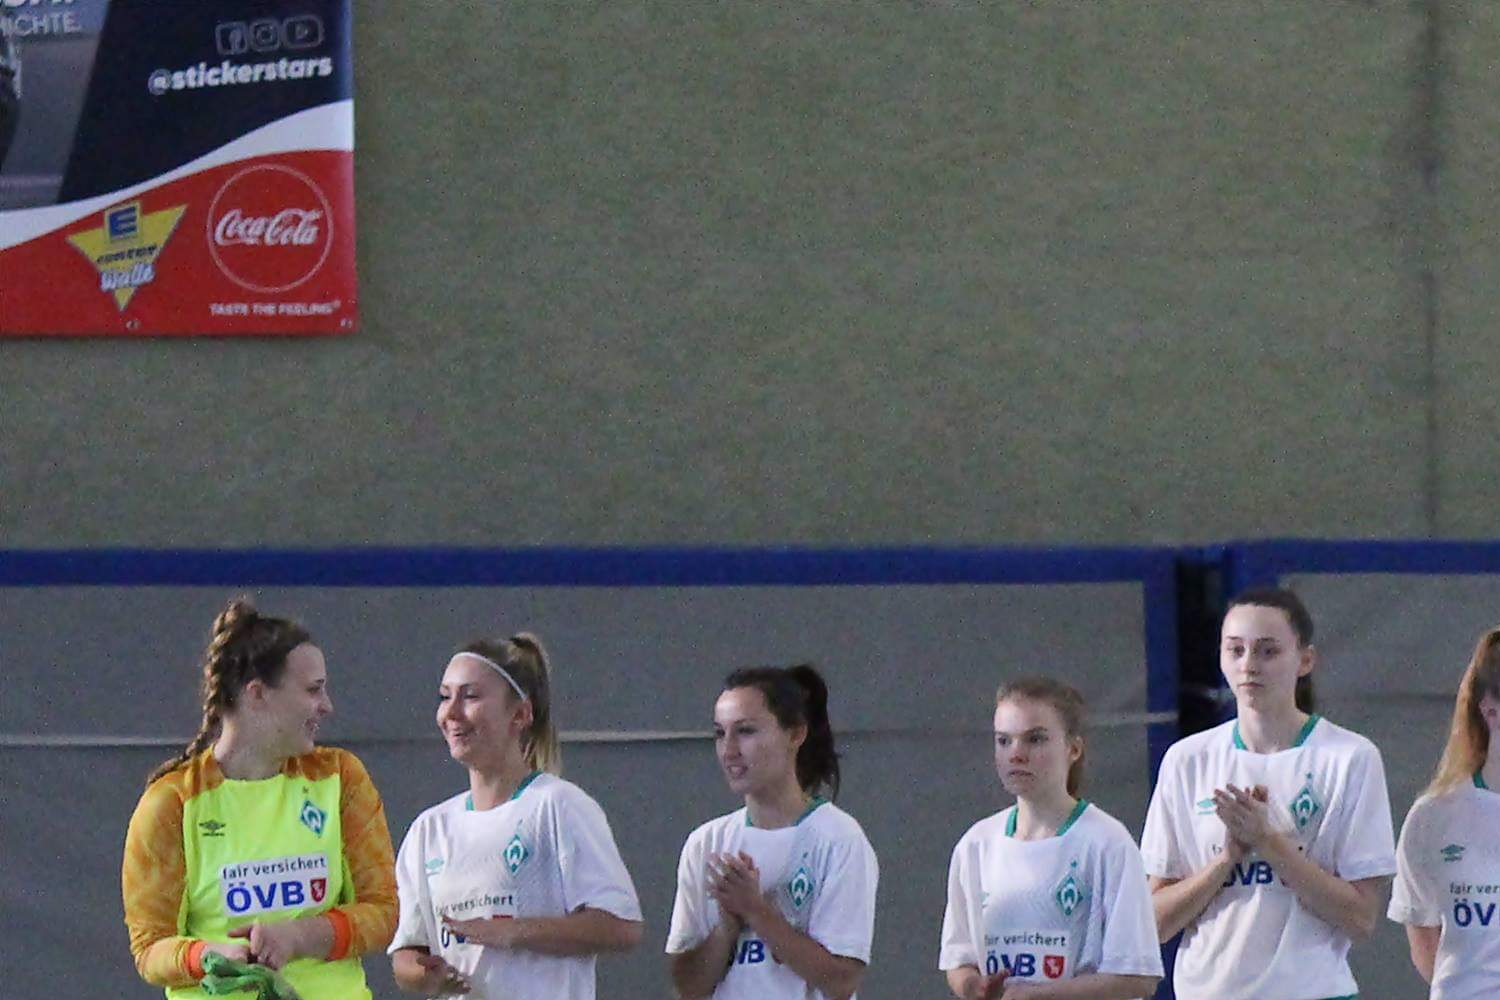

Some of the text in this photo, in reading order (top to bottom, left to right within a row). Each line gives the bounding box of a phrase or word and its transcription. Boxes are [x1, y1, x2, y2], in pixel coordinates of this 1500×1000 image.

[148, 57, 332, 95] @stickerstars
[222, 856, 327, 881] fair versichert
[226, 881, 305, 913] ÖVB
[1450, 882, 1473, 894] fair
